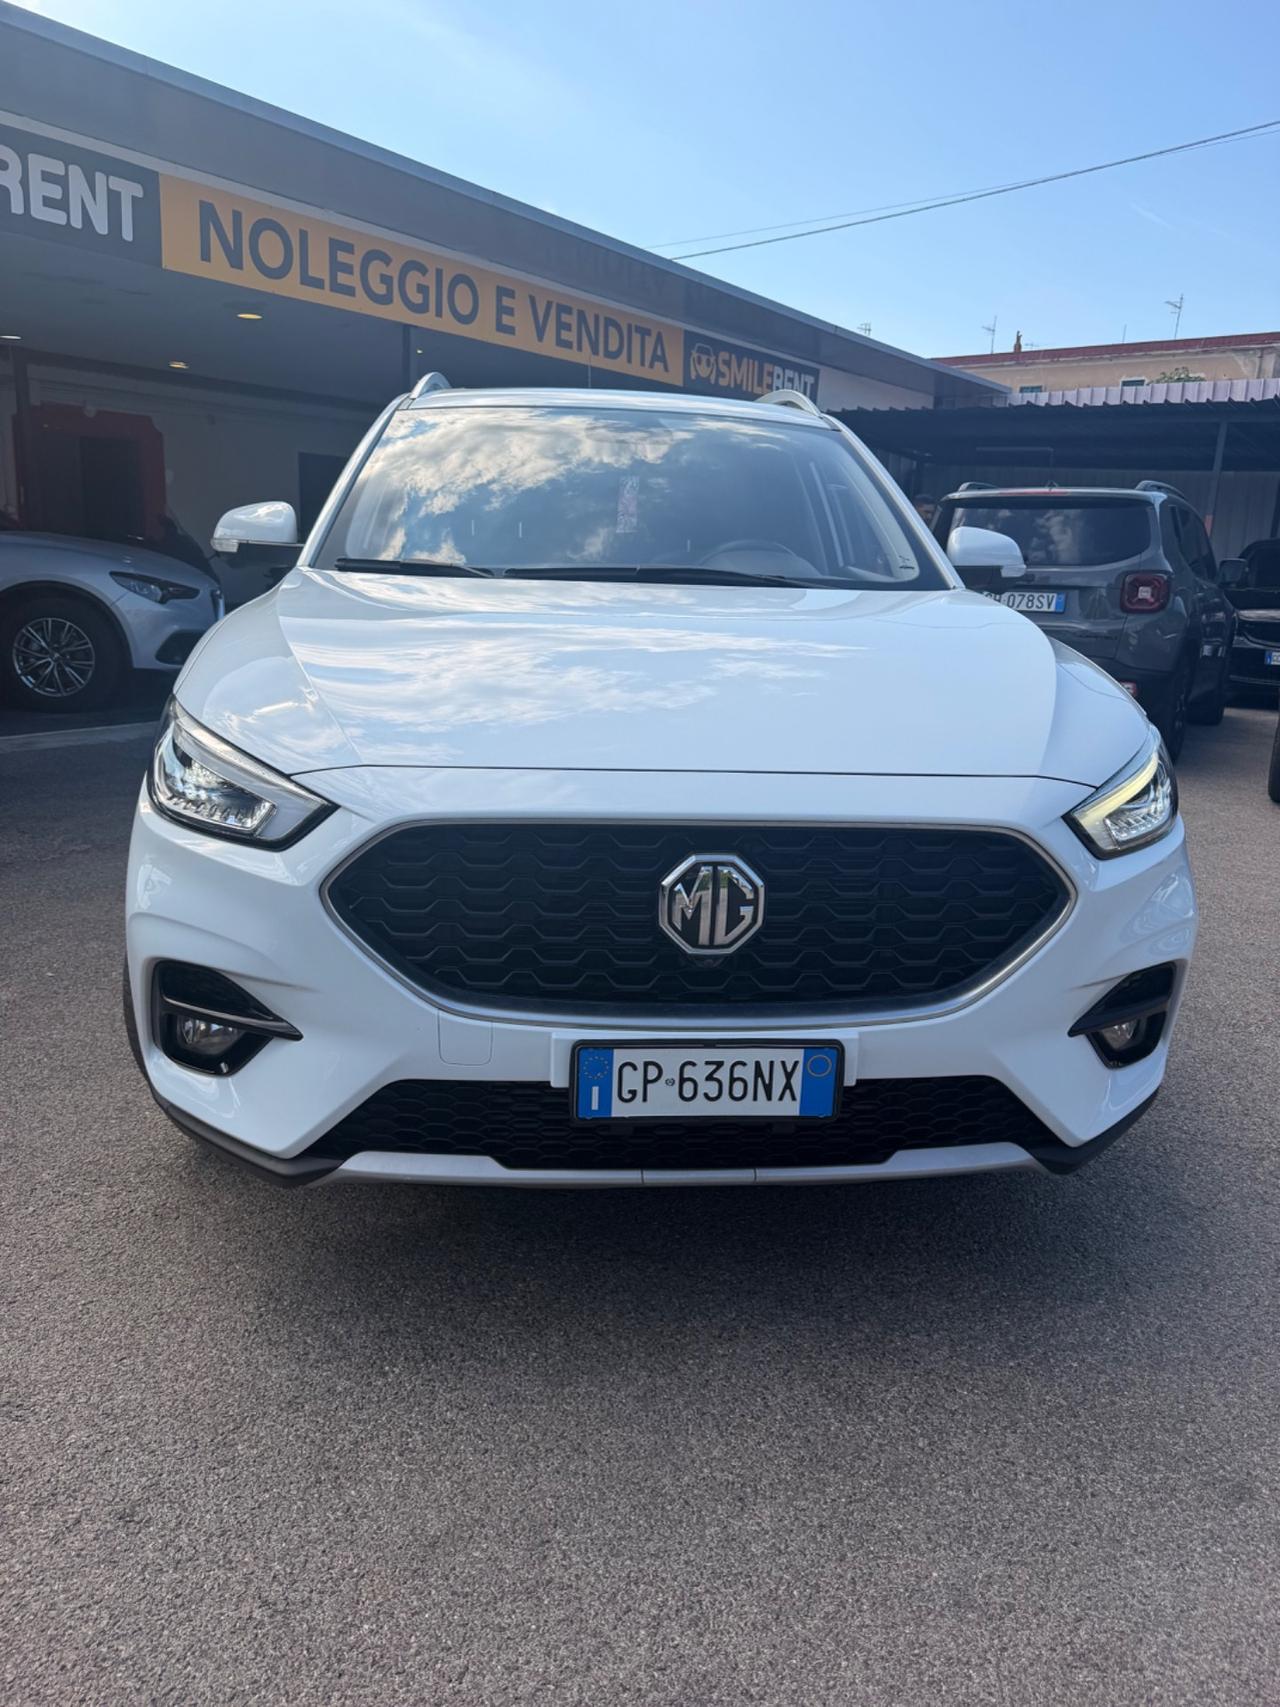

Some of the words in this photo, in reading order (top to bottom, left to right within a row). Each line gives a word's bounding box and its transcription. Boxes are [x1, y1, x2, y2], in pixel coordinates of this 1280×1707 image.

[199, 200, 479, 325] NOLEGGIO
[495, 285, 516, 336] E
[528, 294, 669, 373] VENDITA
[671, 866, 754, 945] MG
